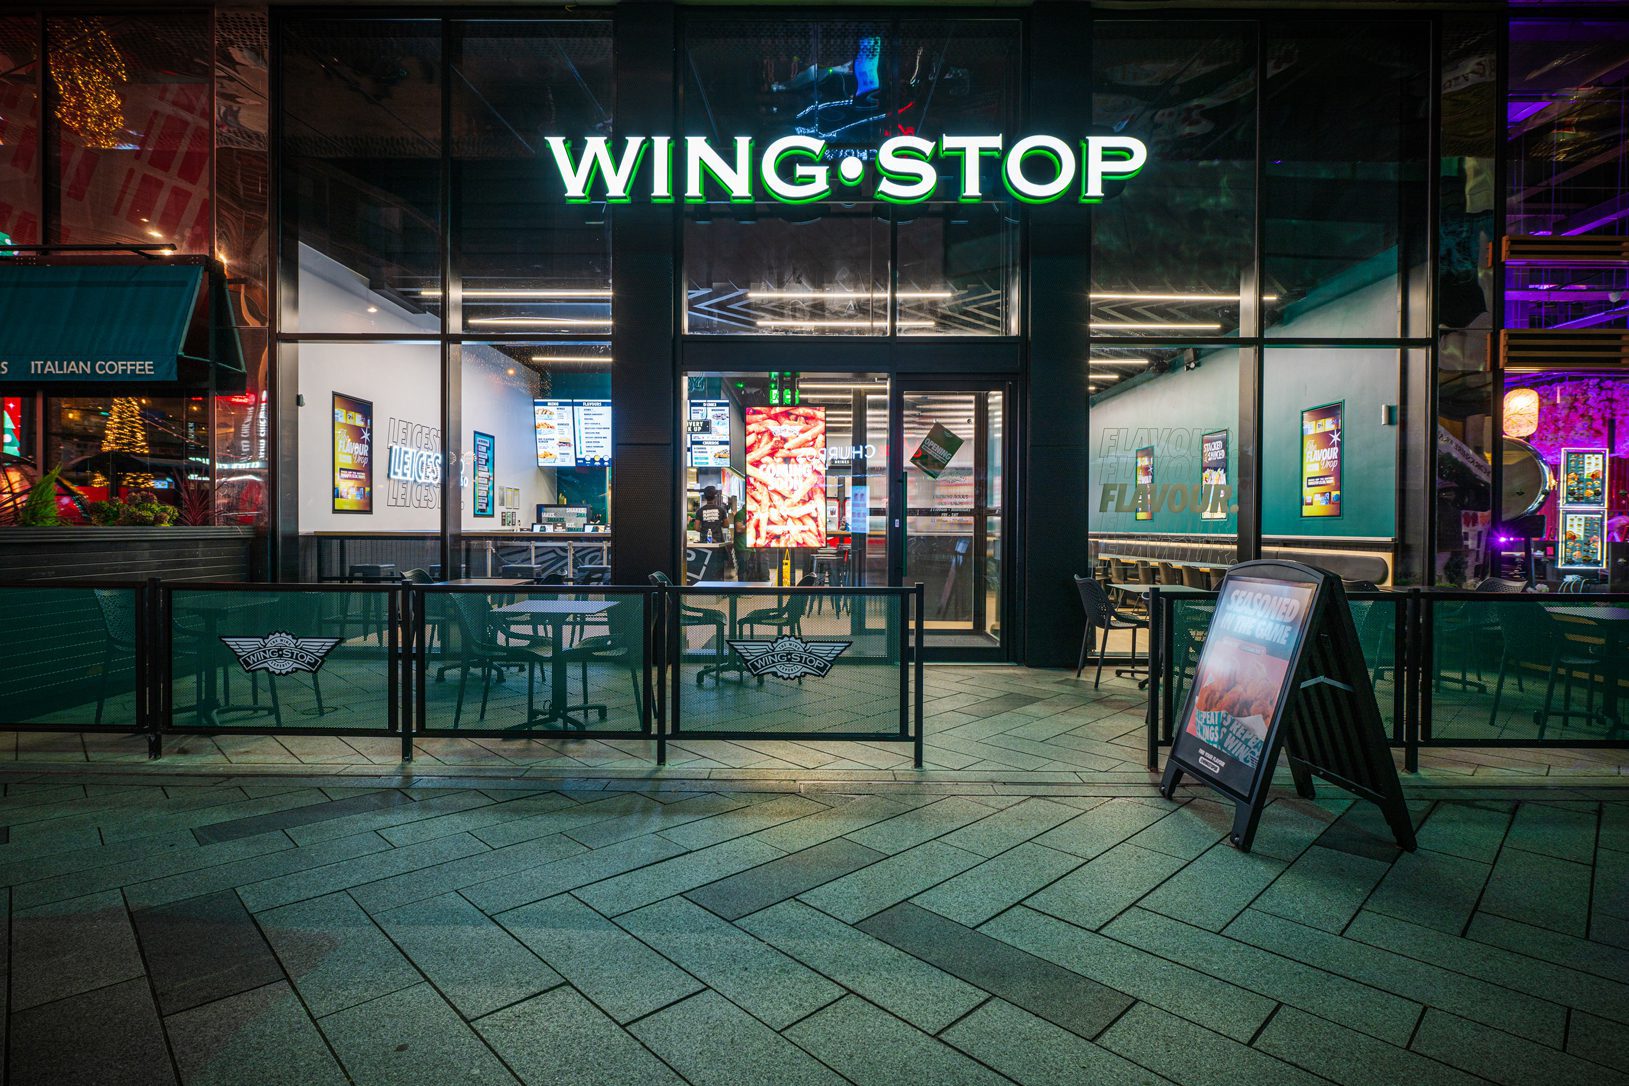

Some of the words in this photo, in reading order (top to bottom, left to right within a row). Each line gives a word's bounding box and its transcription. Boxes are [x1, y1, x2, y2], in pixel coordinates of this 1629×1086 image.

[30, 360, 91, 374] ITALIAN
[95, 360, 155, 375] COFFEE
[338, 439, 368, 456] FLAVOUR
[923, 437, 952, 461] OPENING
[1306, 447, 1339, 463] FLAVOUR
[1226, 589, 1300, 623] SEASONED
[1255, 619, 1293, 645] GAME
